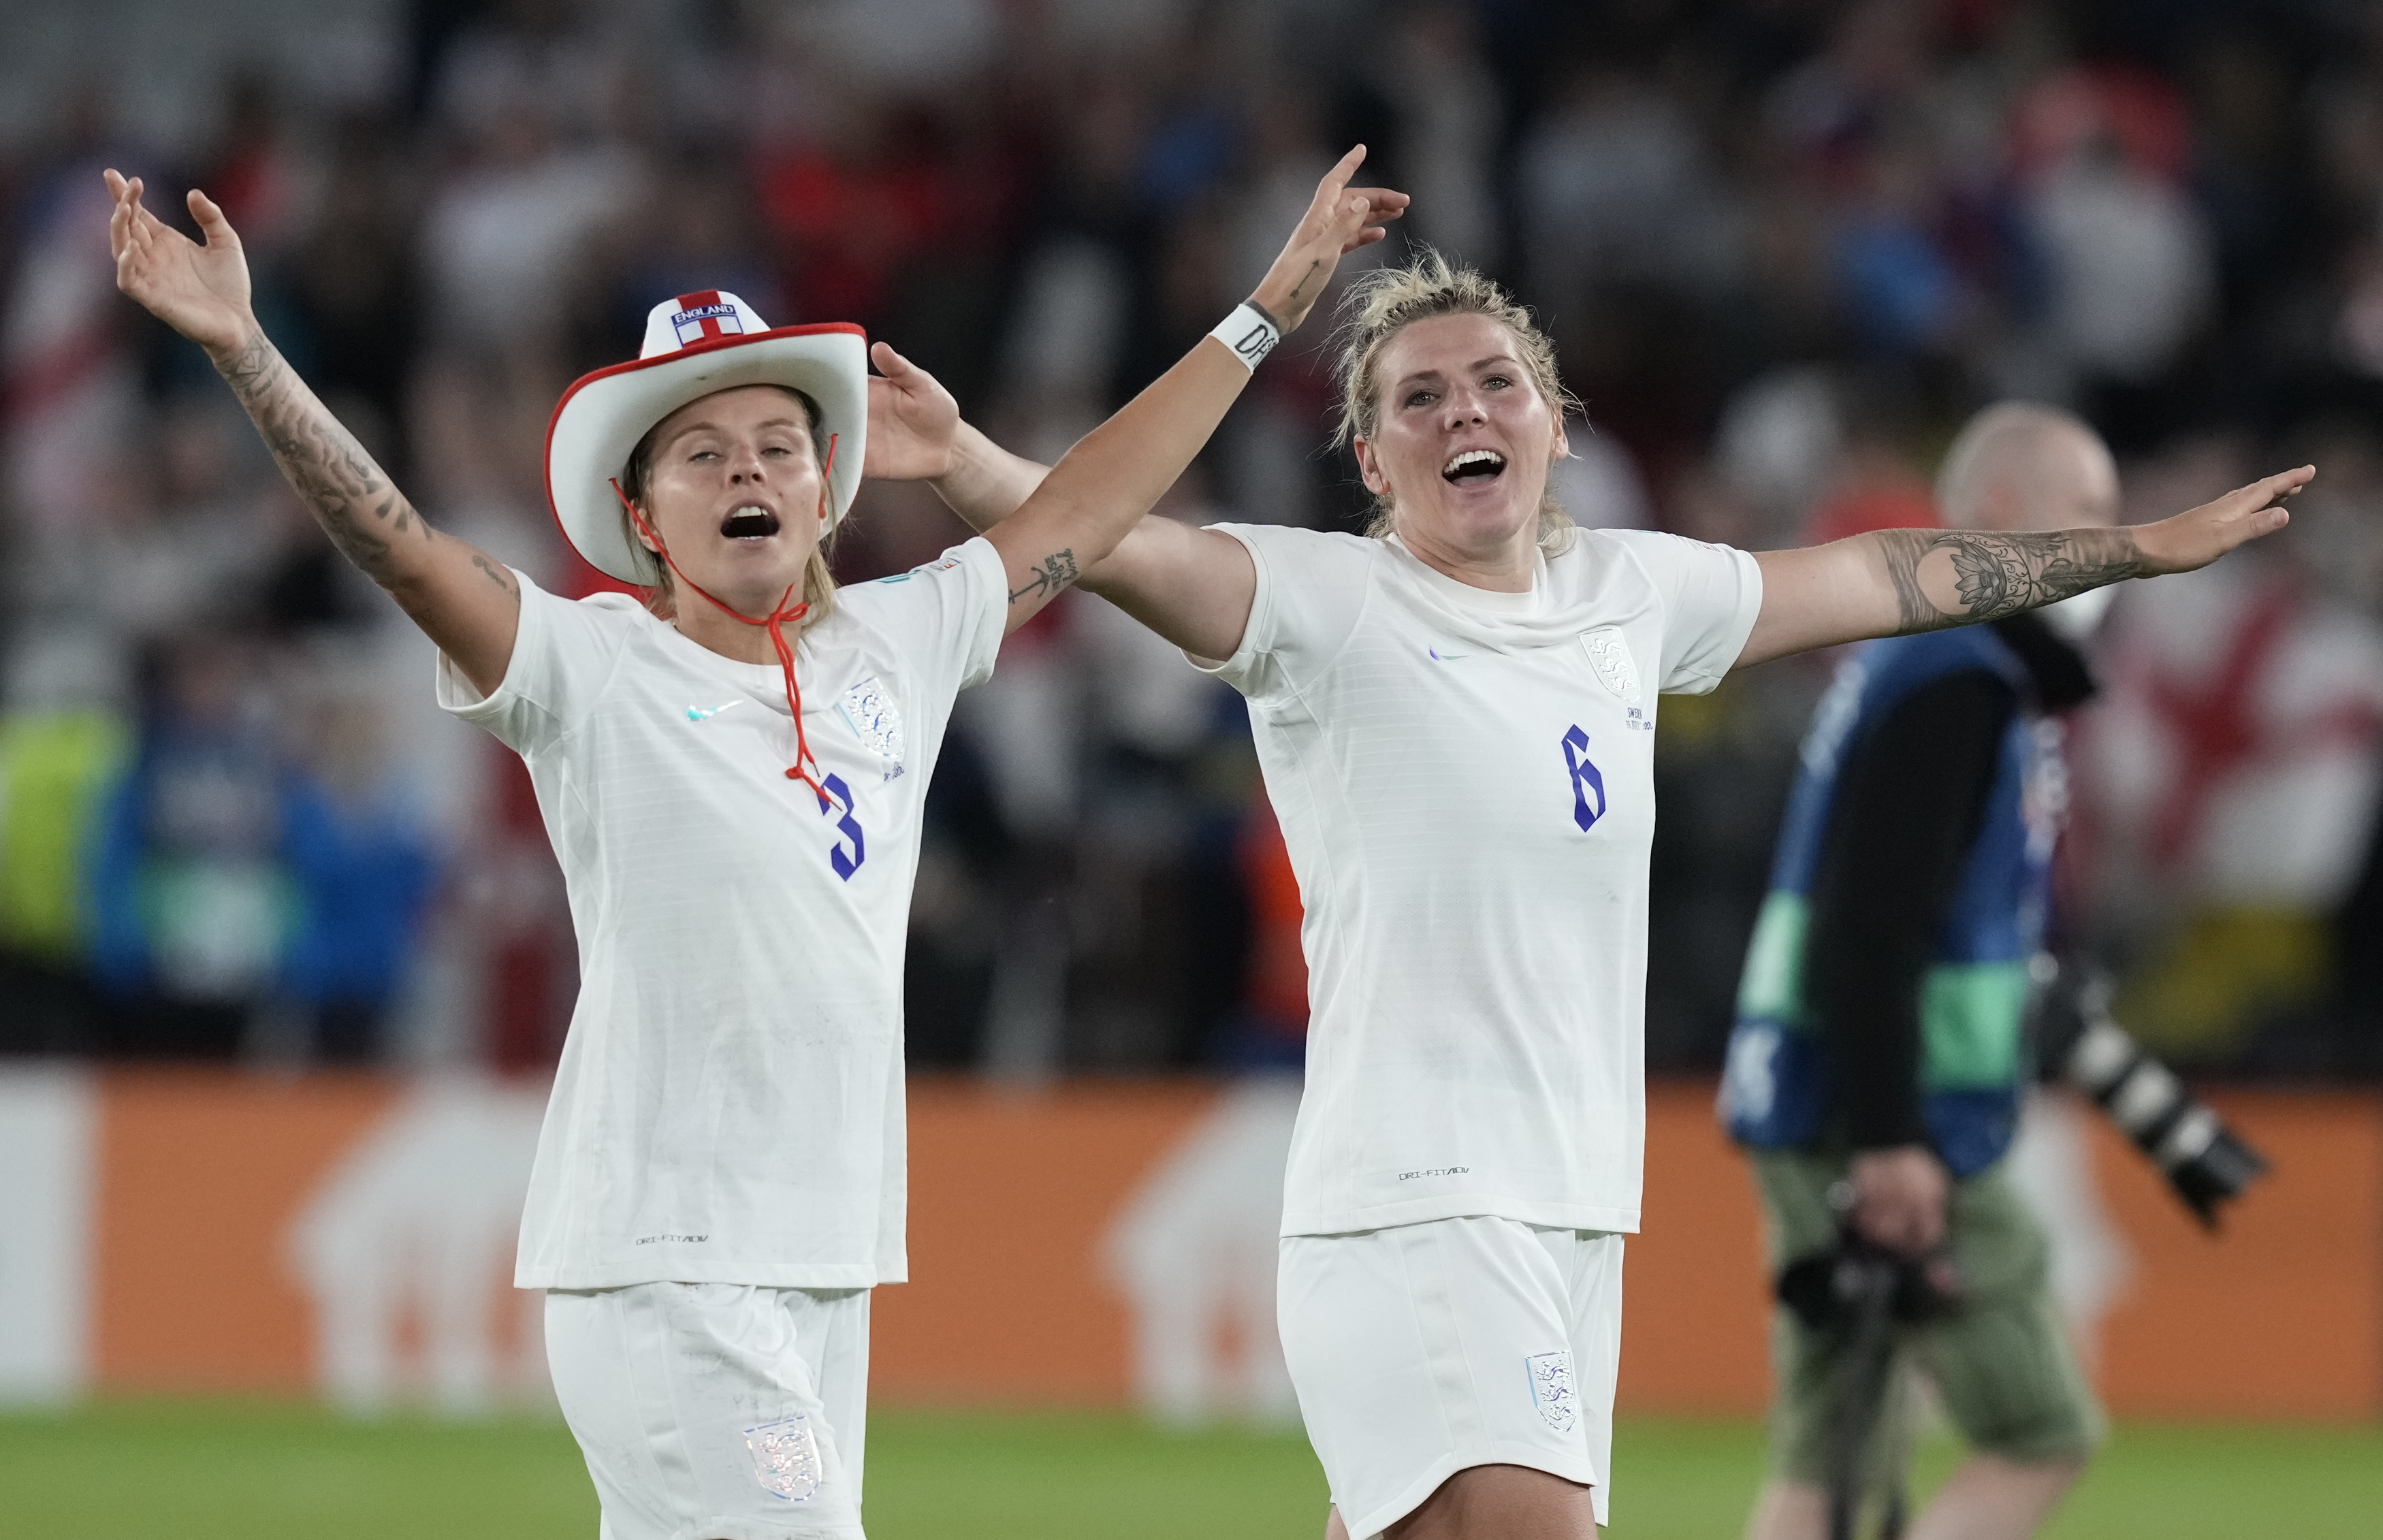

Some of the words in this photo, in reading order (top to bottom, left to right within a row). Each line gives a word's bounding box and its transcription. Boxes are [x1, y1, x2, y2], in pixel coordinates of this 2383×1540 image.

[674, 304, 734, 323] ENGLAND
[817, 771, 865, 882] 3
[1561, 723, 1606, 833] 6
